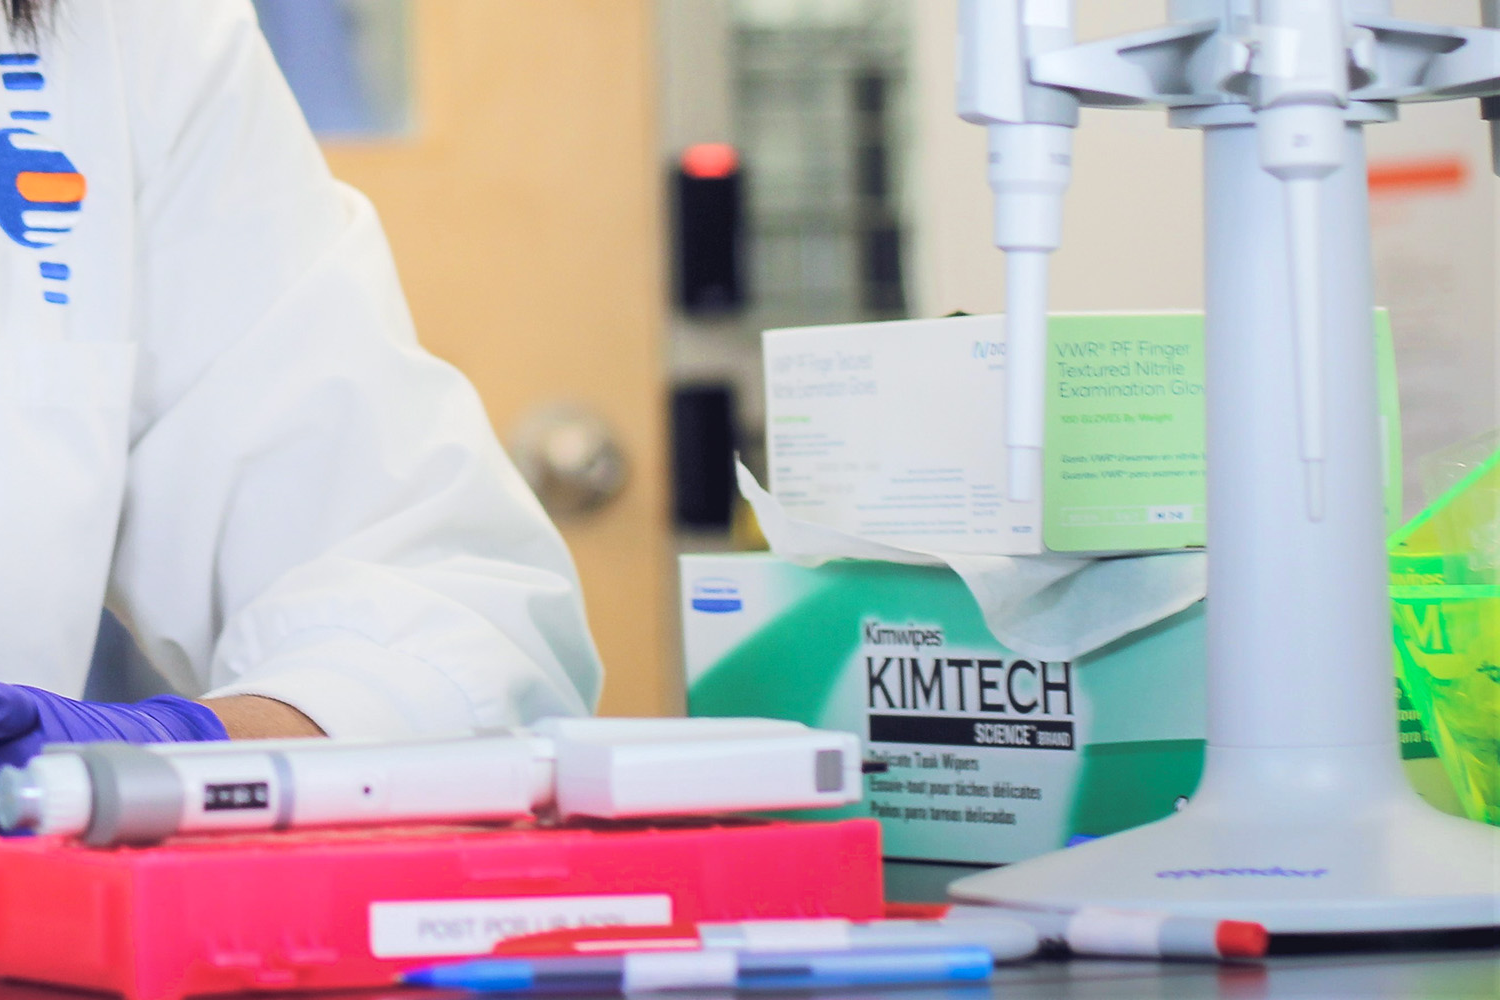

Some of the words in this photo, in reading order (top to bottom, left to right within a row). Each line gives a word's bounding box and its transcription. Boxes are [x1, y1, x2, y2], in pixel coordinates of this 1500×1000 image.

[1110, 340, 1133, 356] PF
[1138, 340, 1191, 360] Finger
[1056, 361, 1131, 378] Textured
[1135, 360, 1186, 377] Nitrile
[1058, 381, 1166, 399] Examination
[865, 621, 943, 649] Kimwipes
[866, 656, 1074, 715] KIMTECH
[1036, 731, 1071, 747] BRAND
[913, 751, 938, 769] Task
[942, 752, 980, 774] Wipers
[417, 916, 476, 940] POST
